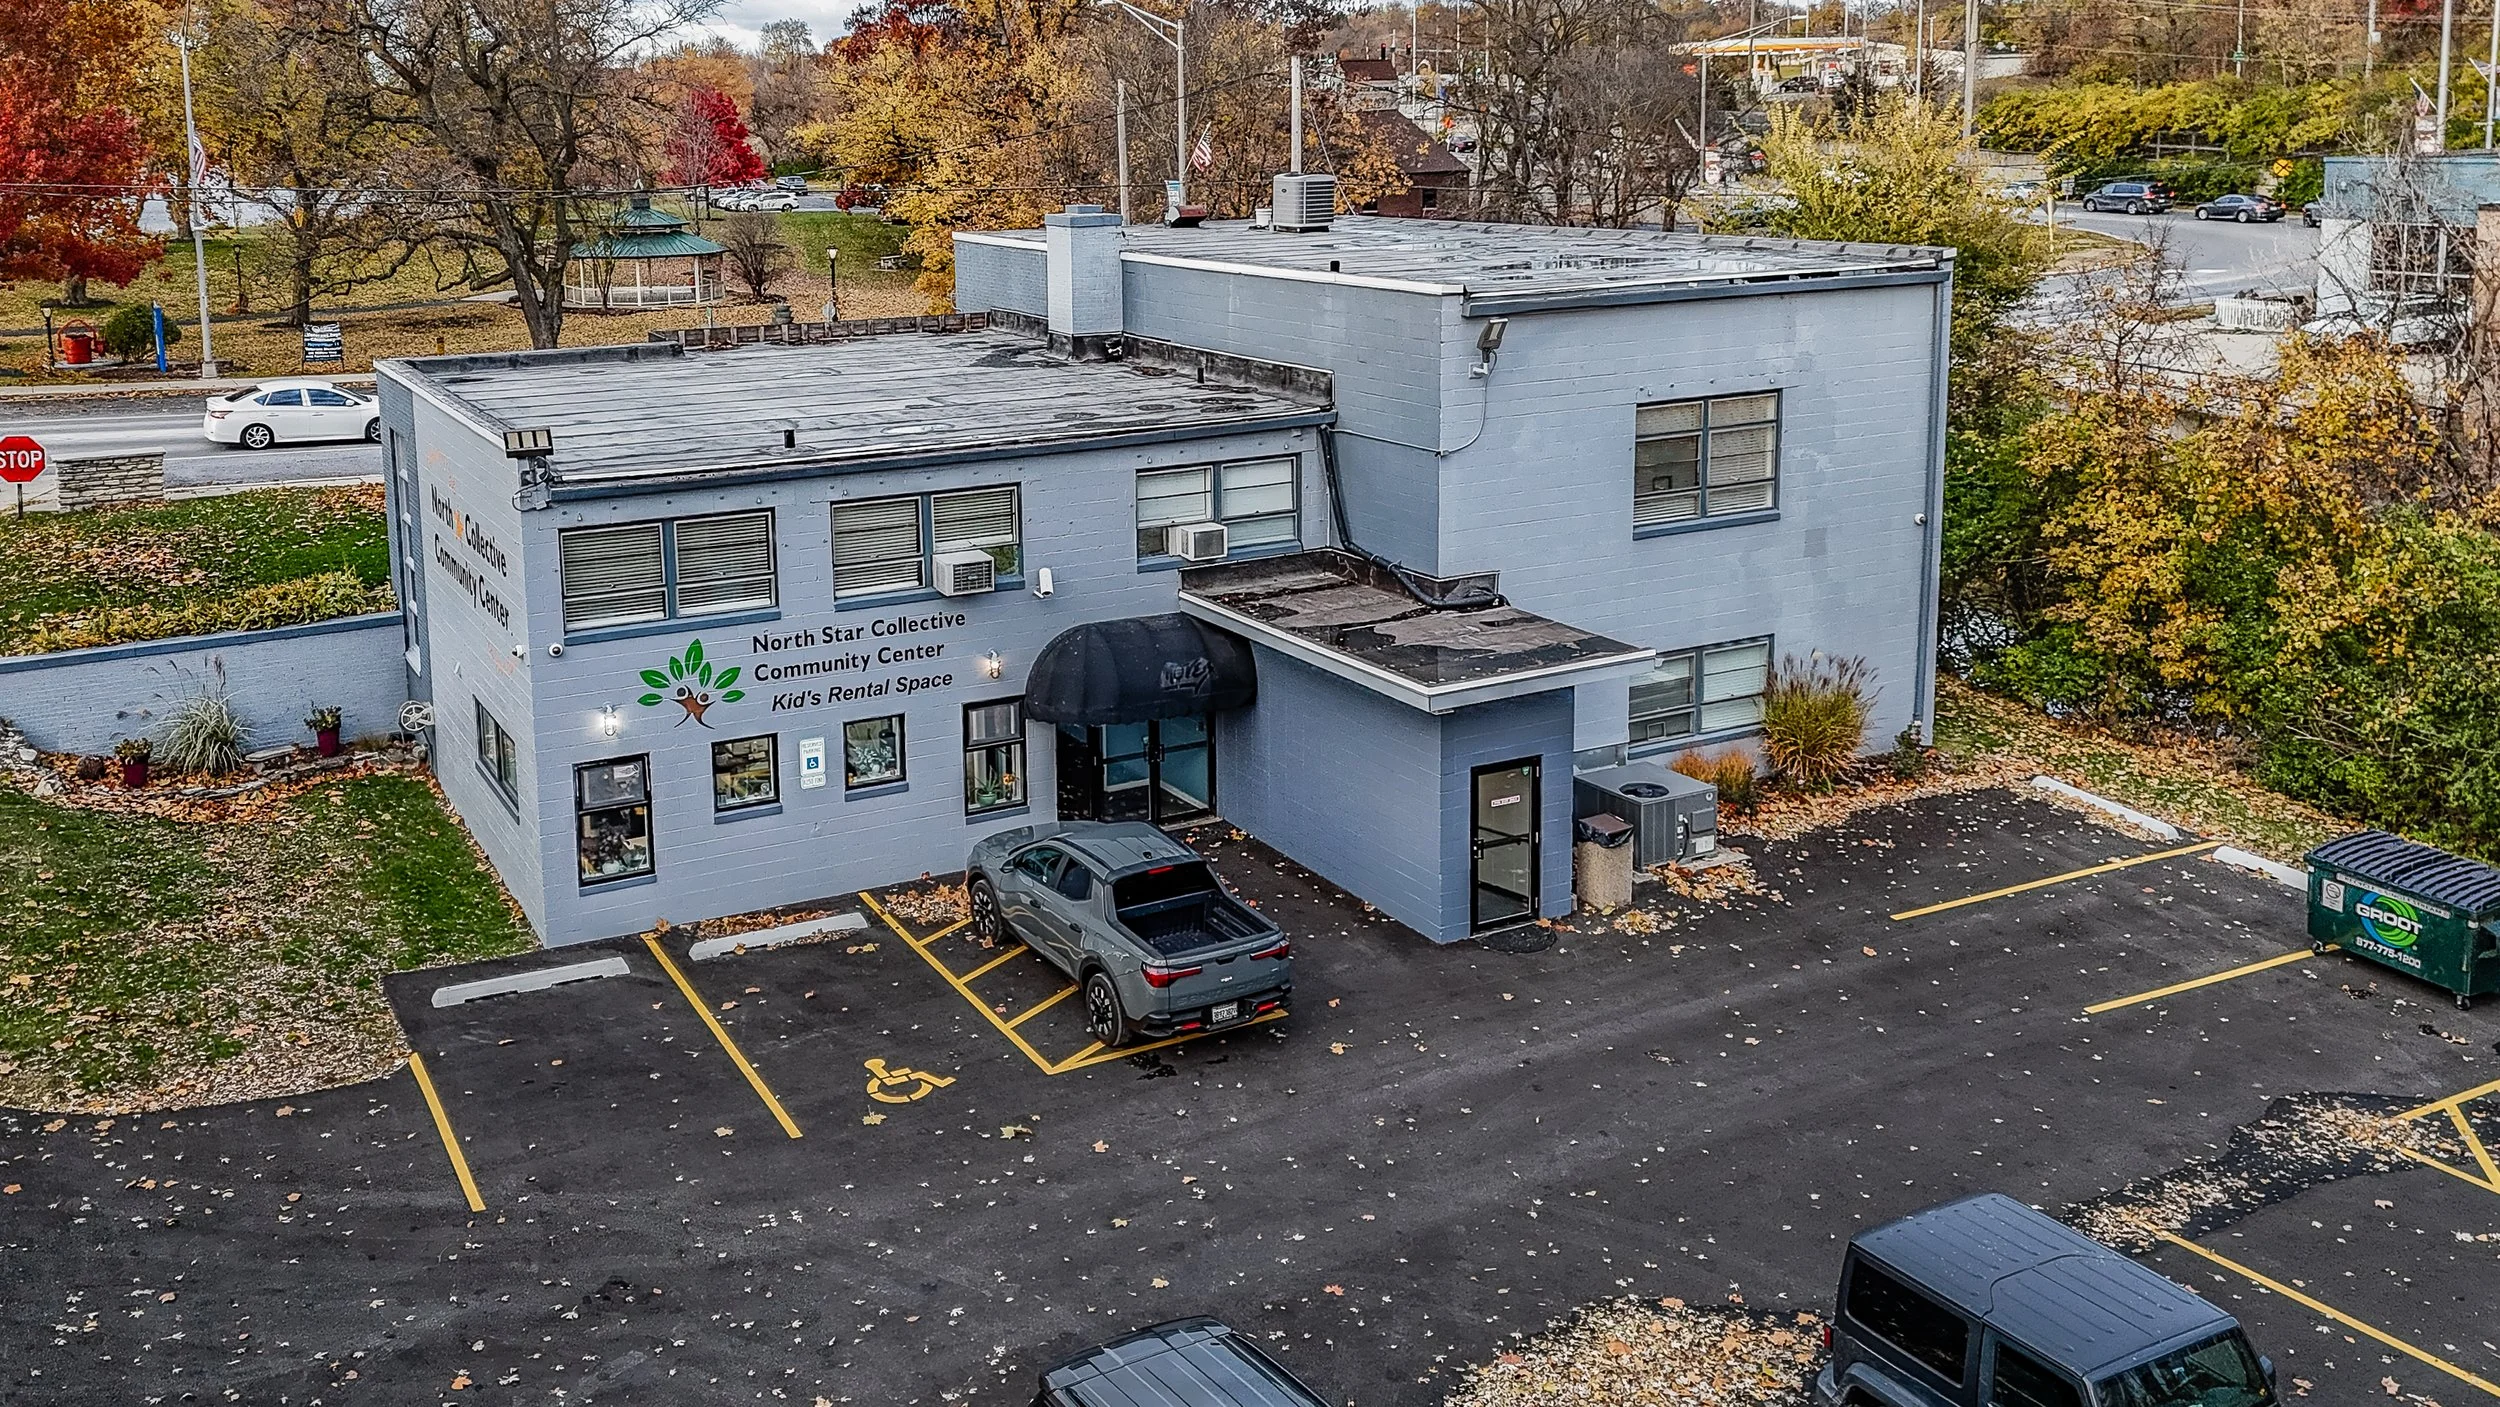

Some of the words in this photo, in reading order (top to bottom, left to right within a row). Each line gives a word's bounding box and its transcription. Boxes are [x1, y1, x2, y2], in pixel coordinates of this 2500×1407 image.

[431, 483, 454, 530] North
[465, 514, 507, 578] Collective
[434, 533, 477, 609] Community
[479, 574, 510, 631] Center
[752, 629, 815, 654] North
[822, 626, 865, 644] Star
[871, 612, 966, 637] Collective
[754, 652, 871, 682] Community
[877, 643, 945, 664] Center
[772, 689, 821, 712] Kid's
[828, 679, 890, 704] Rental
[895, 673, 953, 695] Space
[2356, 904, 2422, 934] GROOT
[2356, 937, 2421, 967] 877-775-1200
